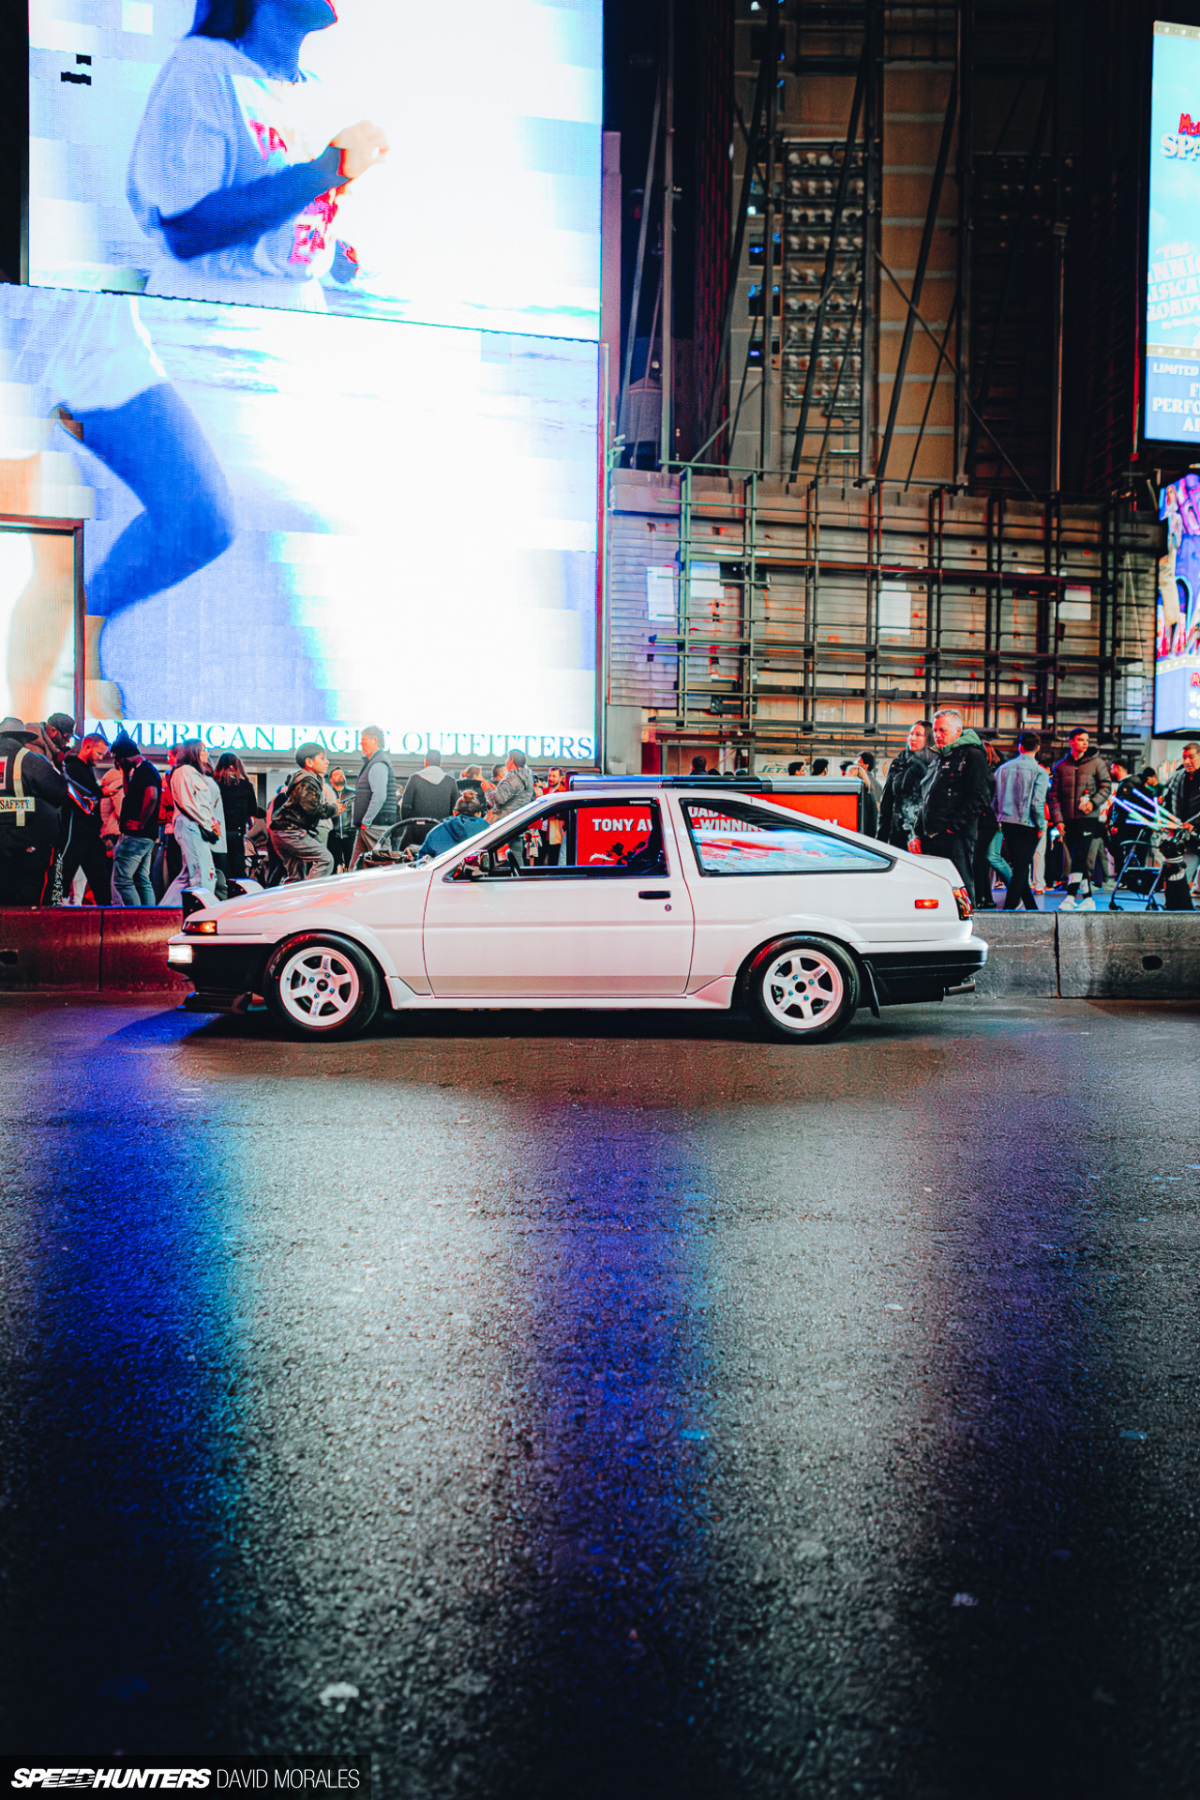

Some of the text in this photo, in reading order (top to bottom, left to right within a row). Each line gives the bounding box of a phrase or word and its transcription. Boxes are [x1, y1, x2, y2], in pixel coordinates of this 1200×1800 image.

[1153, 362, 1199, 377] LIMITED
[94, 721, 593, 760] AMERICAN EAGL OUTFITTERS
[0, 798, 30, 810] SAFETY
[592, 818, 634, 832] TONY
